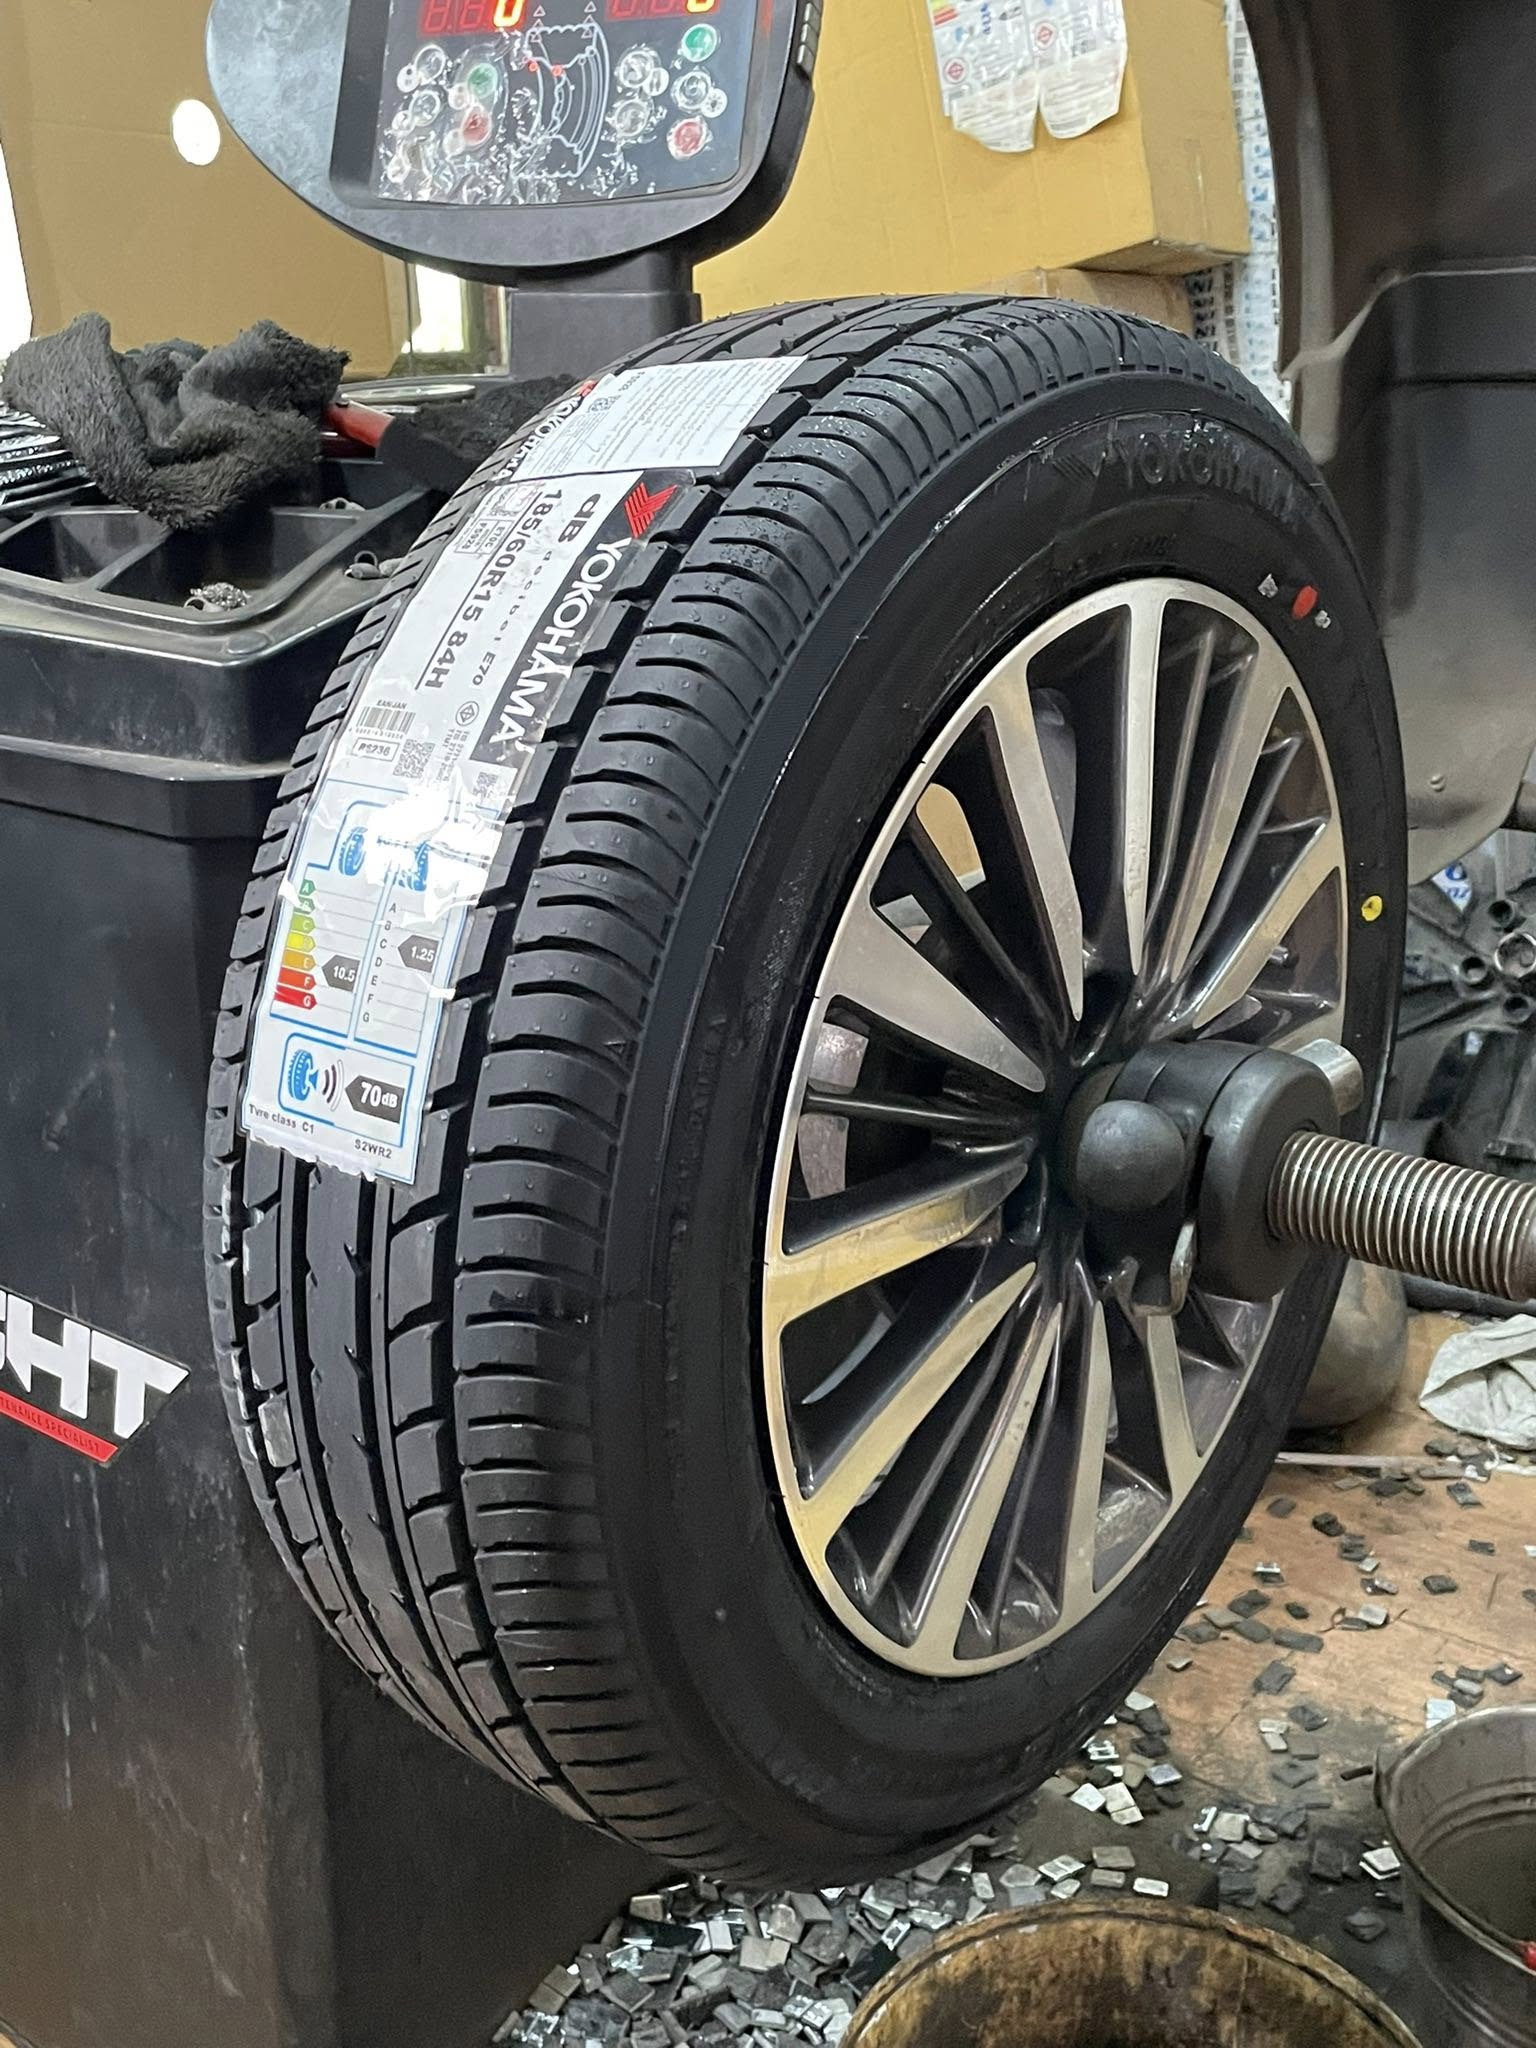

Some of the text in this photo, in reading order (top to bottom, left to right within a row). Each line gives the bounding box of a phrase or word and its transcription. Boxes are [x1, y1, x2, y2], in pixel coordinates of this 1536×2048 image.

[558, 493, 601, 543] dB
[462, 489, 563, 623] 185/60R15
[490, 537, 633, 744] YOKOHAMA
[425, 630, 468, 689] 84H
[472, 651, 497, 686] E70
[389, 902, 397, 913] A
[380, 938, 387, 949] C
[411, 944, 435, 963] 1.25
[375, 957, 383, 968] D
[333, 965, 355, 982] 10.5
[371, 975, 378, 986] E
[367, 993, 374, 1004] F
[362, 1012, 370, 1023] G
[249, 1103, 315, 1134] Tyre class C1
[354, 1139, 393, 1160] S2WR2
[45, 1418, 100, 1453] SPECIALIST
